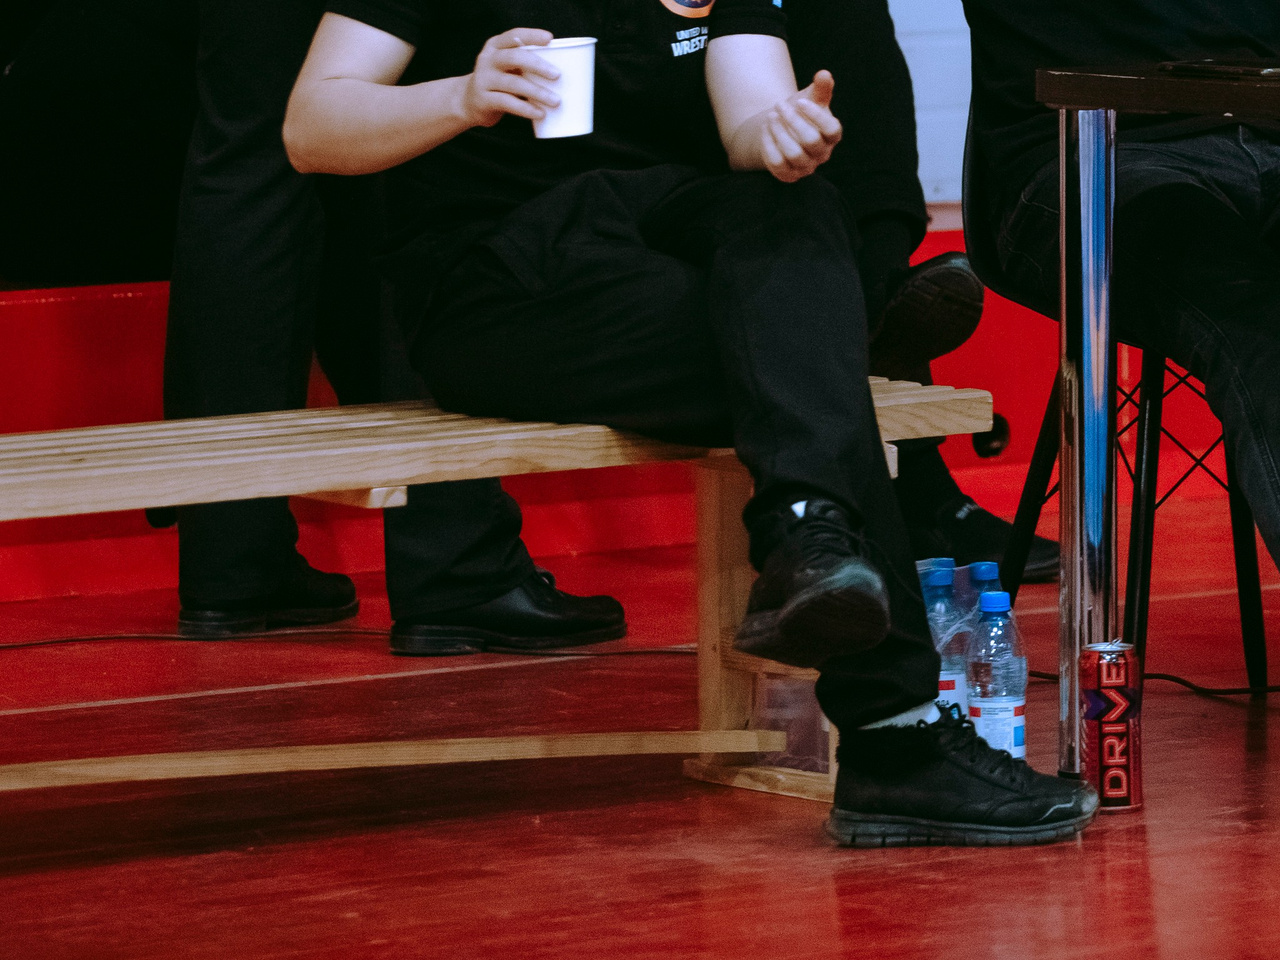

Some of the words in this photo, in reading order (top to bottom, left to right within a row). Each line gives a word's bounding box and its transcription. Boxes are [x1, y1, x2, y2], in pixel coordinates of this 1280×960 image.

[676, 26, 700, 40] UNITED
[671, 35, 708, 57] WREST
[1101, 658, 1130, 798] DRIVE
